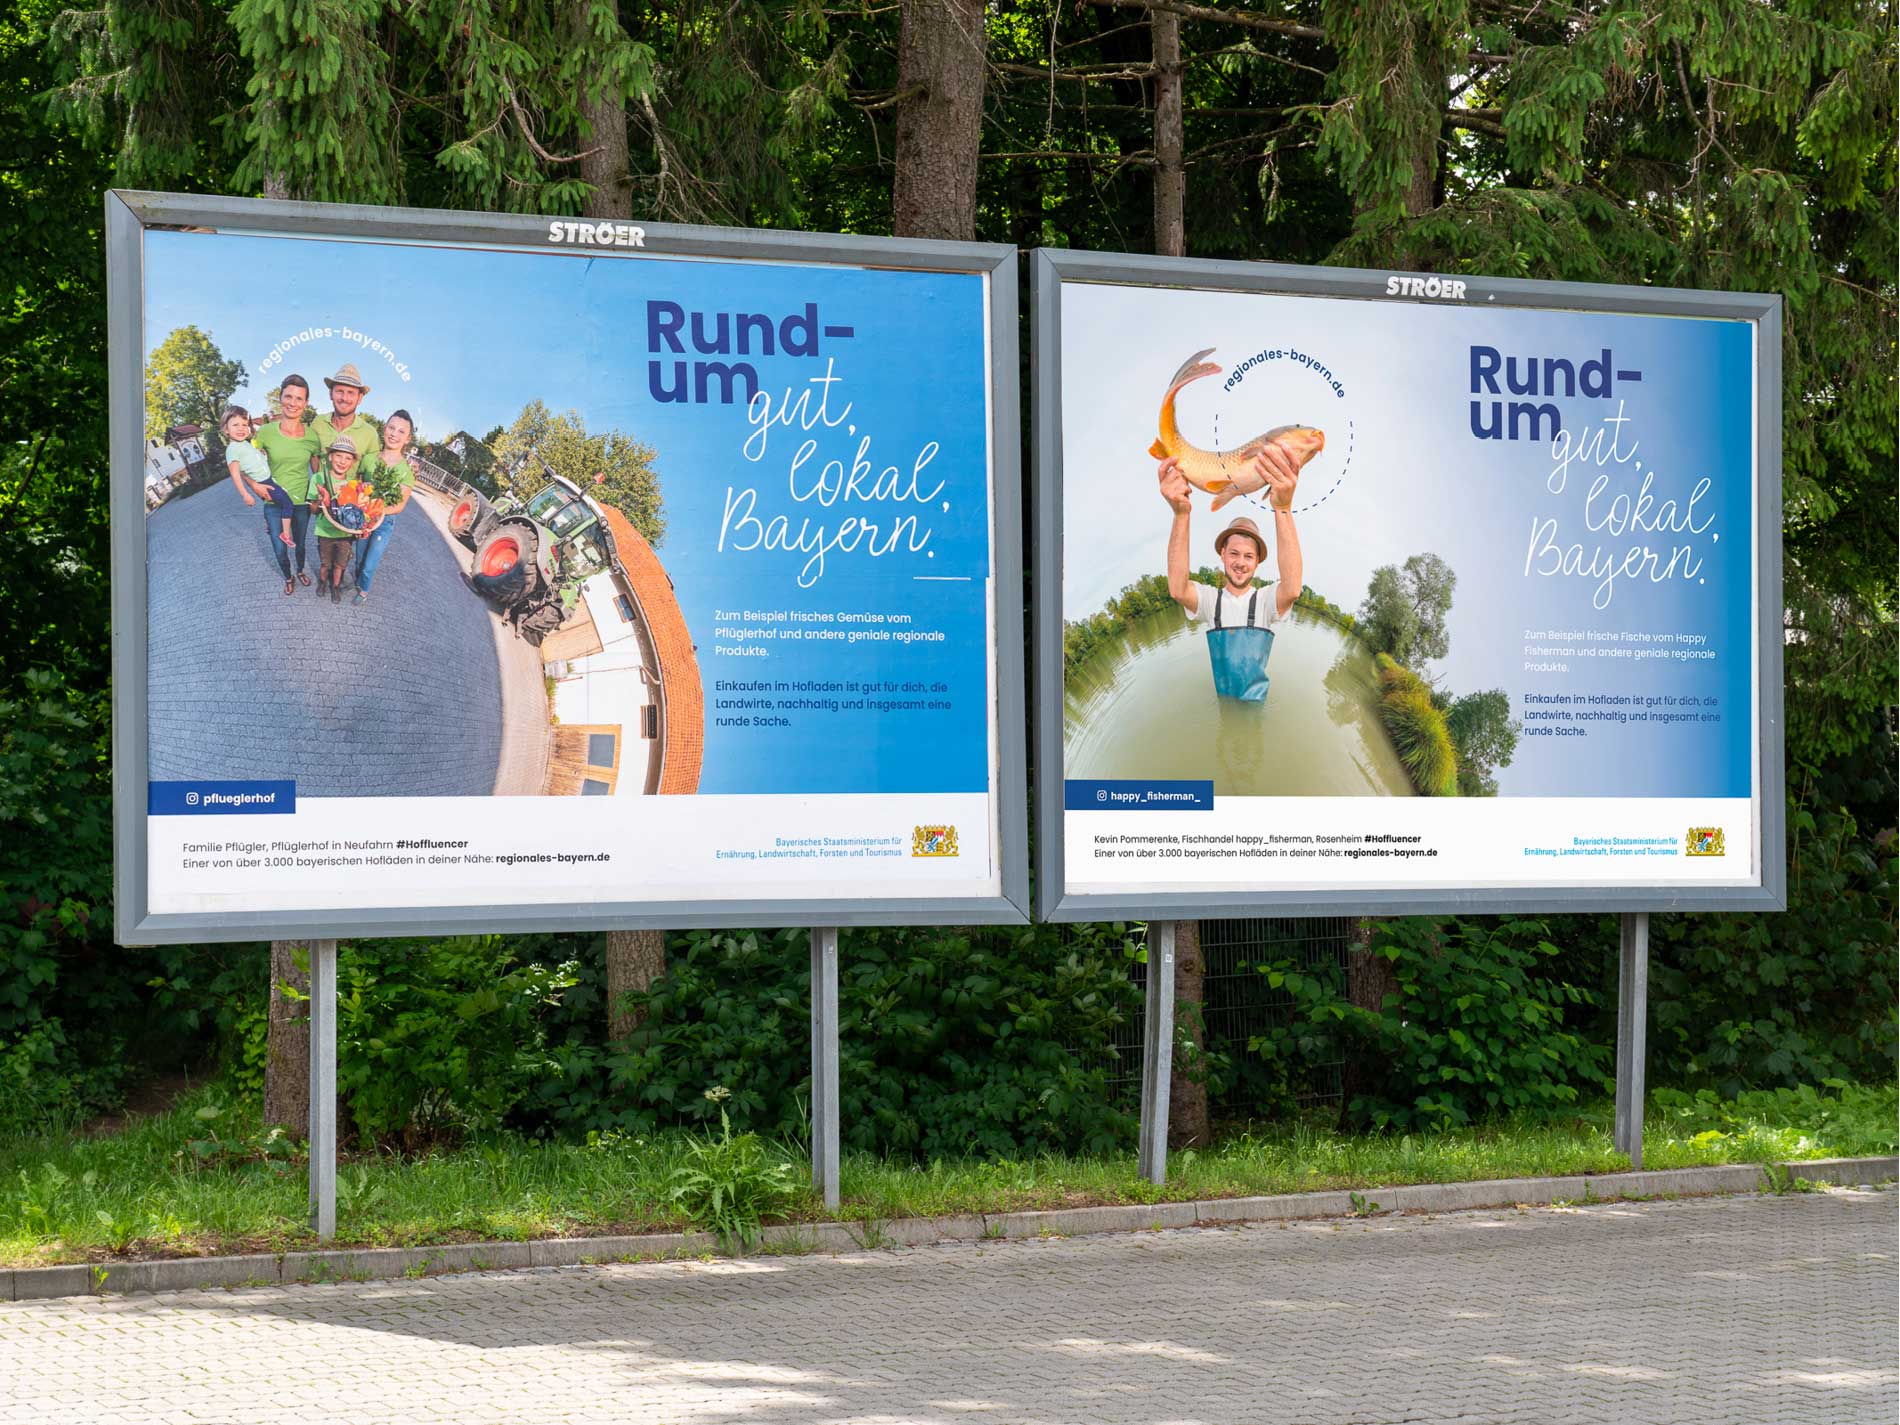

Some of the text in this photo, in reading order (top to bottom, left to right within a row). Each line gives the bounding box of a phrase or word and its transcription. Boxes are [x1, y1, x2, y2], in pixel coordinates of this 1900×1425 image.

[548, 220, 645, 247] STRÖER
[1386, 276, 1466, 300] STRÖER
[647, 300, 854, 357] Rund-
[258, 326, 412, 383] regionales-bayern.de
[1223, 349, 1344, 399] regionales-bayern.de
[1470, 345, 1642, 399] Rund-
[648, 360, 759, 404] um
[743, 357, 856, 461] gut,
[1470, 400, 1561, 442] um
[1547, 399, 1642, 494] gut,
[789, 435, 950, 512] lokal,
[1585, 471, 1719, 544] lokal,
[717, 486, 935, 588] Bayern.
[1524, 517, 1705, 610] Bayern.
[715, 610, 911, 624] Zum Beispiel frisches Gemüse vom
[715, 628, 945, 643] Pflüglerhof und andere geniale regionale
[1524, 631, 1707, 646] Zum Beispiel frische Fische vom Happy
[716, 646, 770, 657] Produkte.
[1524, 646, 1716, 661] Fisherman und andere geniale regionale
[1524, 662, 1570, 673] Produkte.
[716, 681, 948, 695] Einkaufen im Hofladen ist gut für dich, die
[716, 699, 952, 712] Landwirte, nachhaltig und insgesamt eine
[1524, 694, 1718, 708] Einkaufen im Hofladen ist gut für dich, die
[716, 716, 792, 727] runde Sache.
[1524, 711, 1720, 724] Landwirte, nachhaltig und insgesamt eine
[1524, 726, 1587, 737] runde Sache.
[203, 793, 275, 805] pflueglerhof
[1111, 792, 1201, 803] happy_fisherman_
[183, 839, 468, 854] Familie Pflügler, Pflüglerhof in Neufahrn #Hoffluencer
[776, 836, 902, 848] Bayerisches Staatsministerium für
[1094, 835, 1421, 845] Kevin Pommerenke, Fischhandel happy_fisherman, Rosenheim #Hoffluencer
[1574, 837, 1678, 846] Bayerisches Staatsministerium für
[716, 847, 902, 861] Ernährung, Landwirtschaft, Forsten und Tourismus
[1094, 848, 1438, 859] Einer von über 3.000 bayerischen Hofläden in deiner Nähe: regionales-bayern.de
[1525, 847, 1678, 857] Ernährung, Landwirtschaft, Forsten und Tourismus
[183, 853, 610, 868] Einer von über 3.000 bayerischen Hofläden in deiner Nähe: regionales-bayern.de
